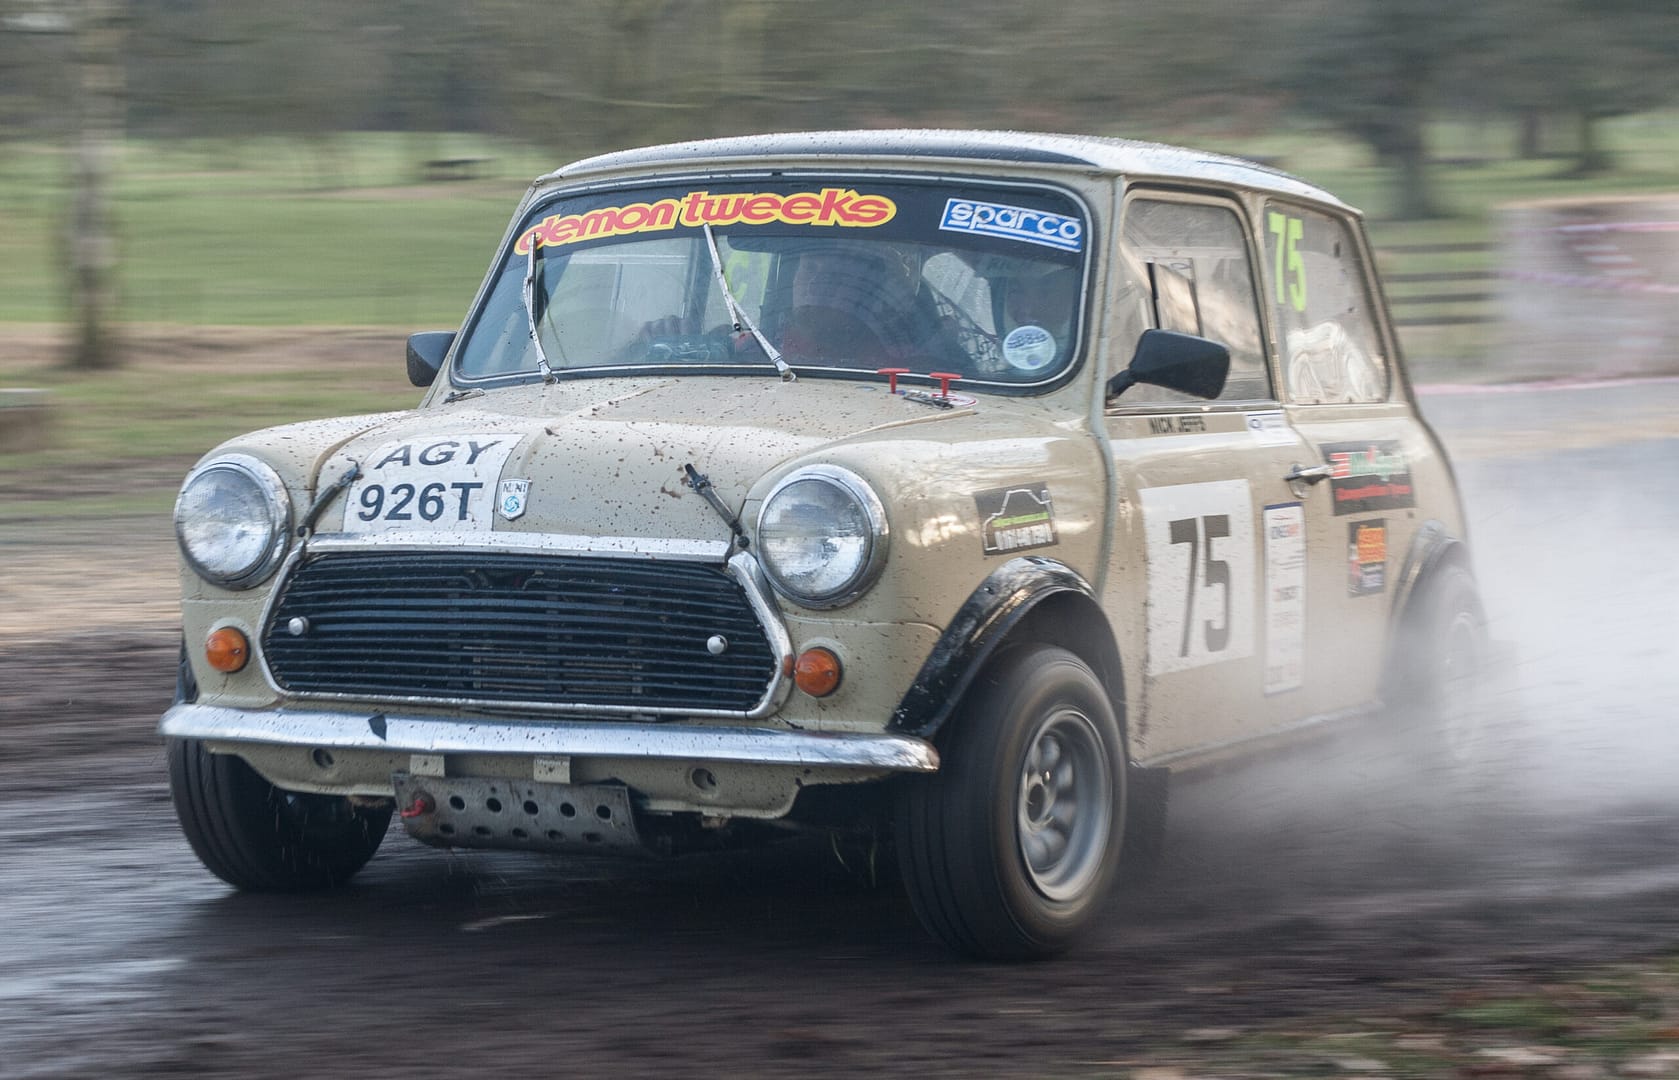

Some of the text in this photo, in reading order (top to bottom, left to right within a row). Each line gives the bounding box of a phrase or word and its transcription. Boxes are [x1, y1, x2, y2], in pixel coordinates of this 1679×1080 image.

[517, 188, 897, 254] demon tweeks
[949, 200, 1082, 248] sparco
[1269, 211, 1307, 312] 75
[1150, 416, 1176, 434] NICK
[374, 440, 503, 470] AGY
[358, 482, 484, 522] 926T
[1170, 514, 1232, 658] 75
